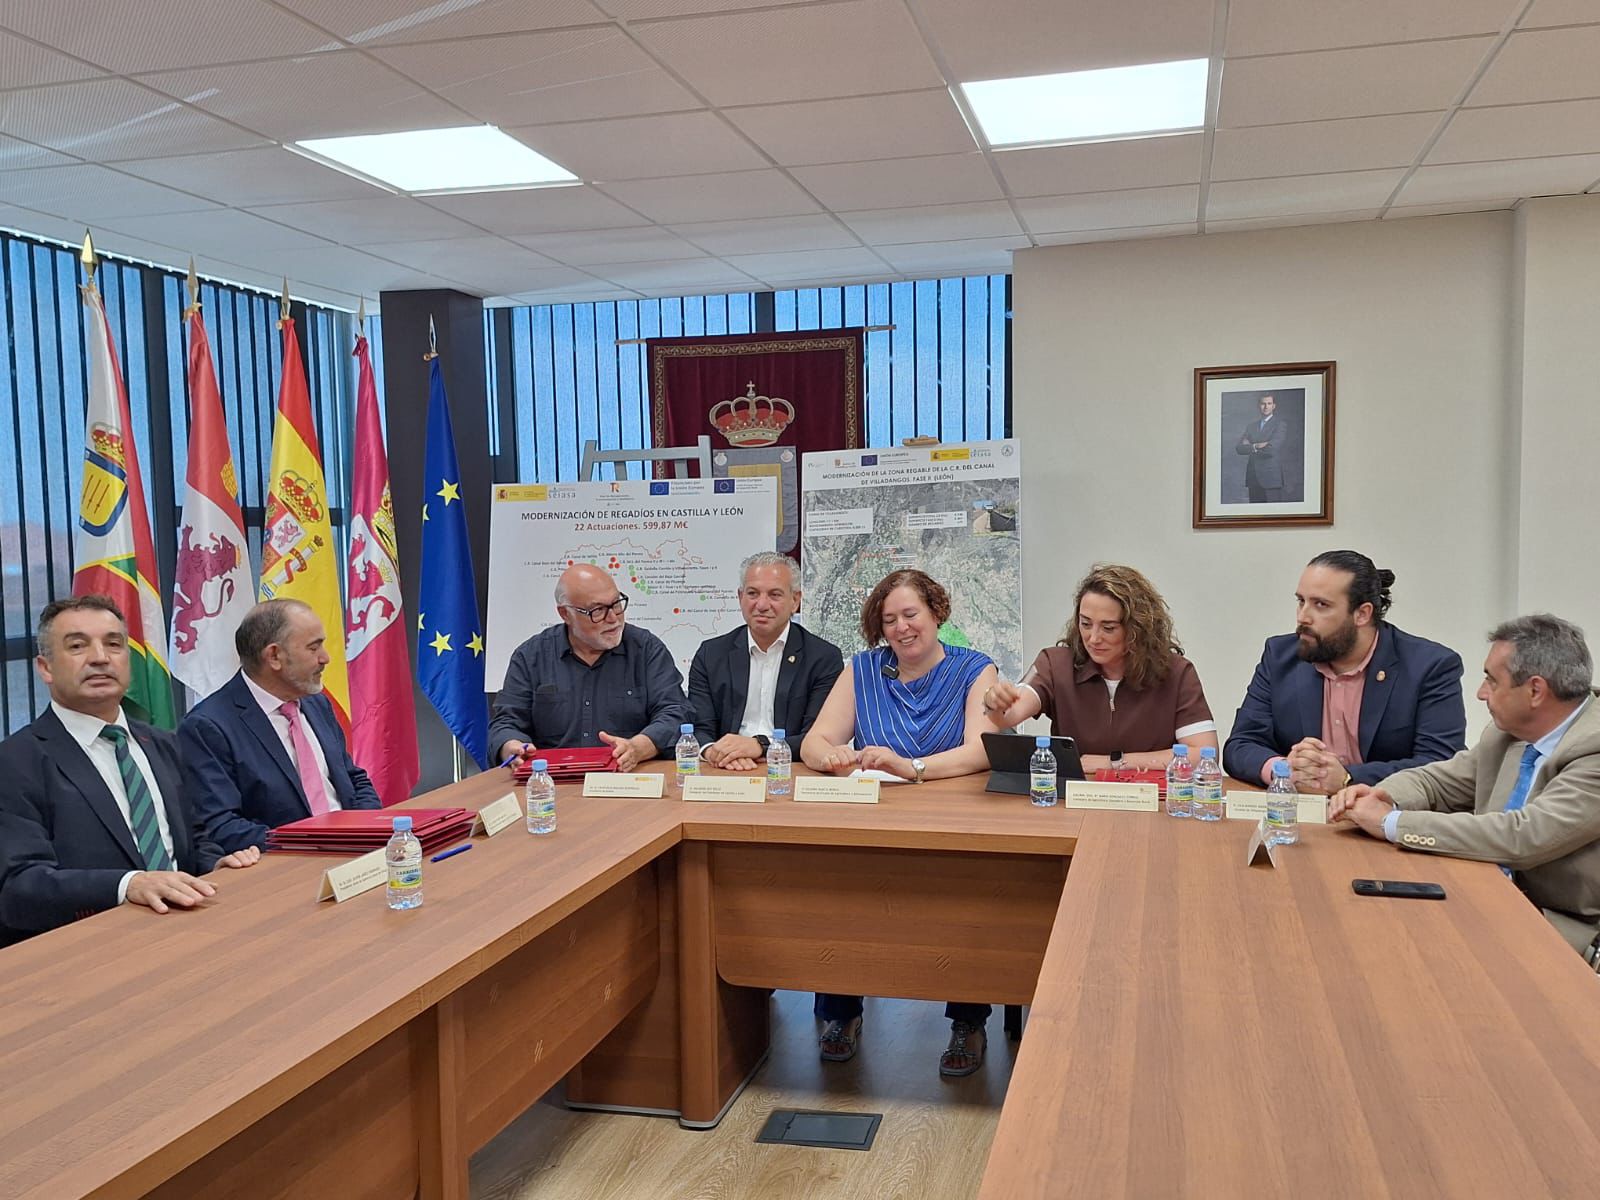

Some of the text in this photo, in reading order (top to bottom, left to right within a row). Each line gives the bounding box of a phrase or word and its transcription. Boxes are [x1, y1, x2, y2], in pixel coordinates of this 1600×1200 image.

[822, 471, 870, 479] MODERNIZACIÓN
[934, 473, 954, 481] (LEÓN)
[521, 506, 744, 521] MODERNIZACIÓN DE REGADÍOS EN CASTILLA Y LEÓN
[574, 520, 689, 531] 22 Actuaciones. 599,87 M€
